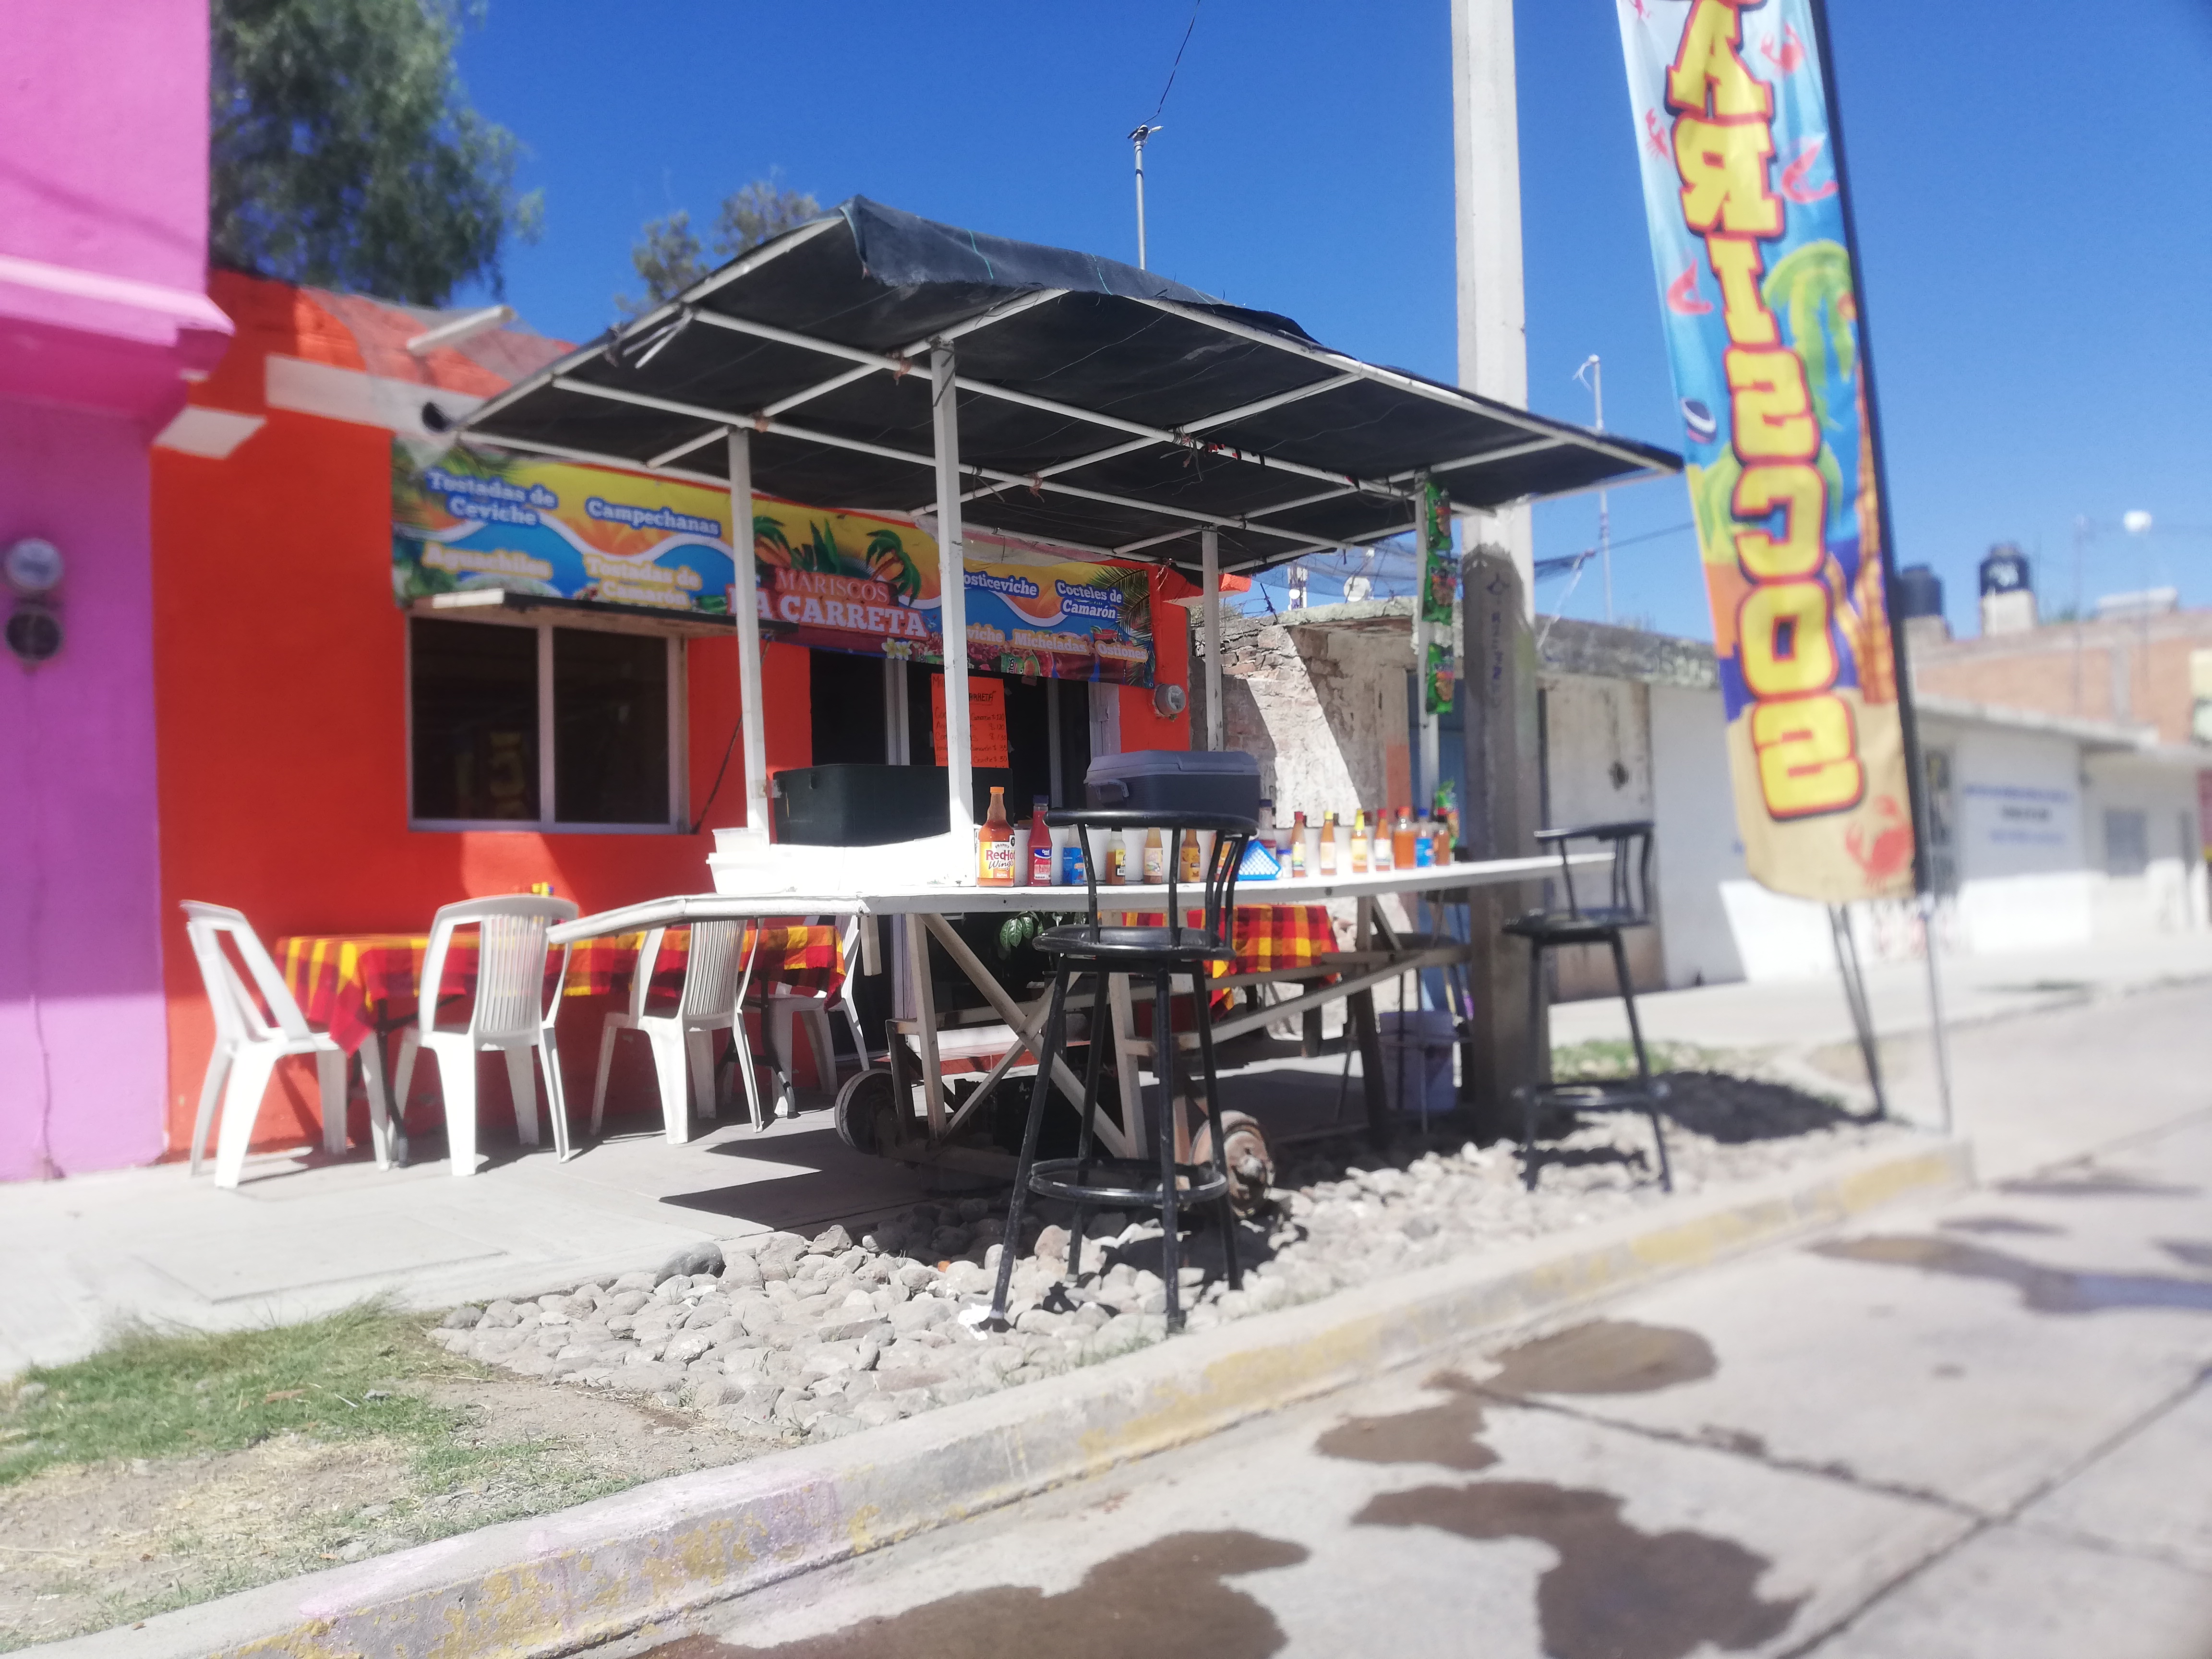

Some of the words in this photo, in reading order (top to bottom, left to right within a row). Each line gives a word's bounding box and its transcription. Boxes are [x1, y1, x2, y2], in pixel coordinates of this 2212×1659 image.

[426, 470, 526, 502] Tostadas
[529, 488, 555, 507] de
[450, 495, 537, 526] Ceviche
[588, 498, 719, 535] Campechanas
[677, 570, 699, 588] de
[778, 569, 888, 603] MARISCOS
[964, 573, 1037, 596] osticeviche
[1057, 582, 1107, 601] Cocteles
[1109, 589, 1122, 603] de
[780, 594, 927, 638] CARRETA
[1063, 599, 1116, 619] Camarón
[1015, 632, 1087, 653] Micheladas
[1097, 643, 1146, 658] Ostiones
[988, 860, 1013, 870] Wings
